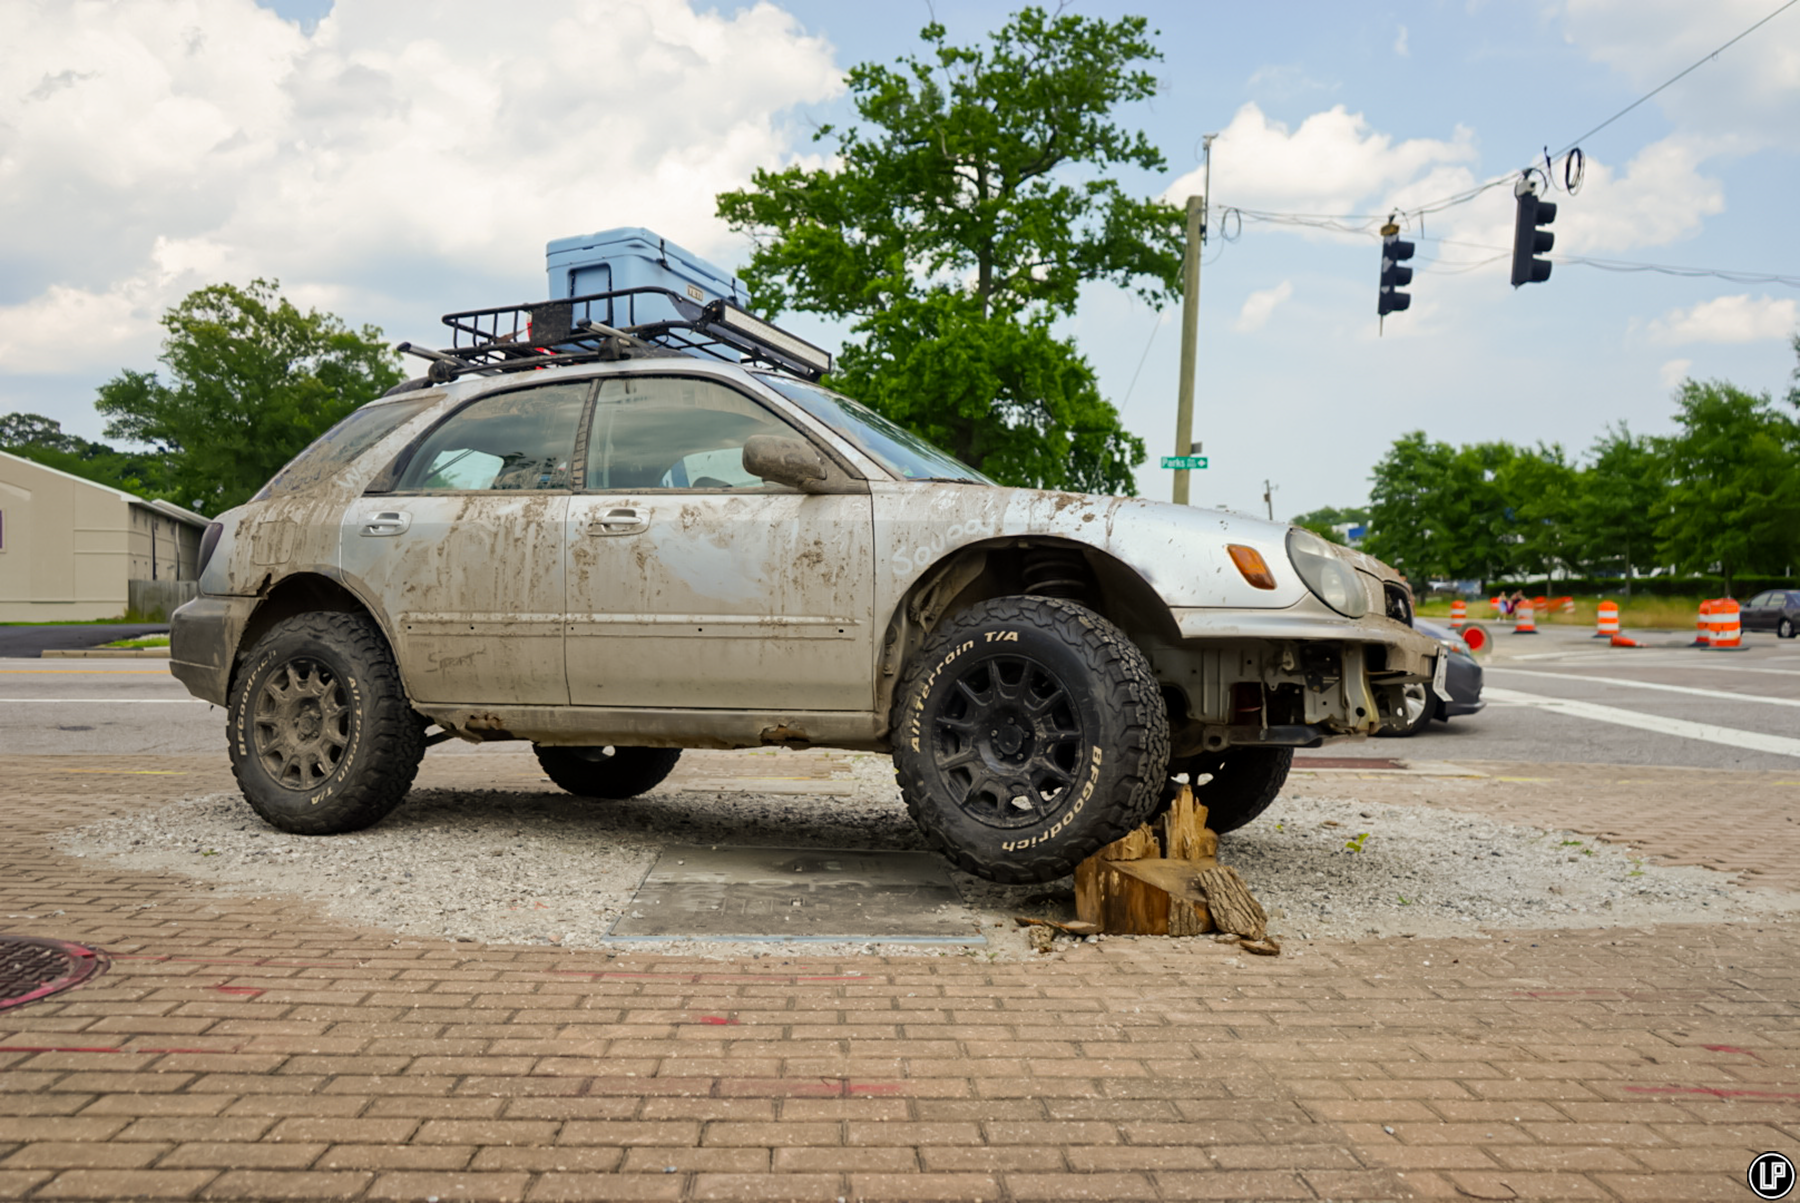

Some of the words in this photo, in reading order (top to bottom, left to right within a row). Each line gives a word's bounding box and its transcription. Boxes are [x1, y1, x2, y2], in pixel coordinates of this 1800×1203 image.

[1162, 457, 1185, 468] Parks
[237, 649, 277, 756] BFGoodrich
[338, 676, 363, 783] All-Terrain
[911, 640, 975, 753] All-Terrain
[984, 630, 1019, 643] T/A
[311, 786, 334, 805] T/A
[1001, 745, 1103, 852] BFGoodrich
